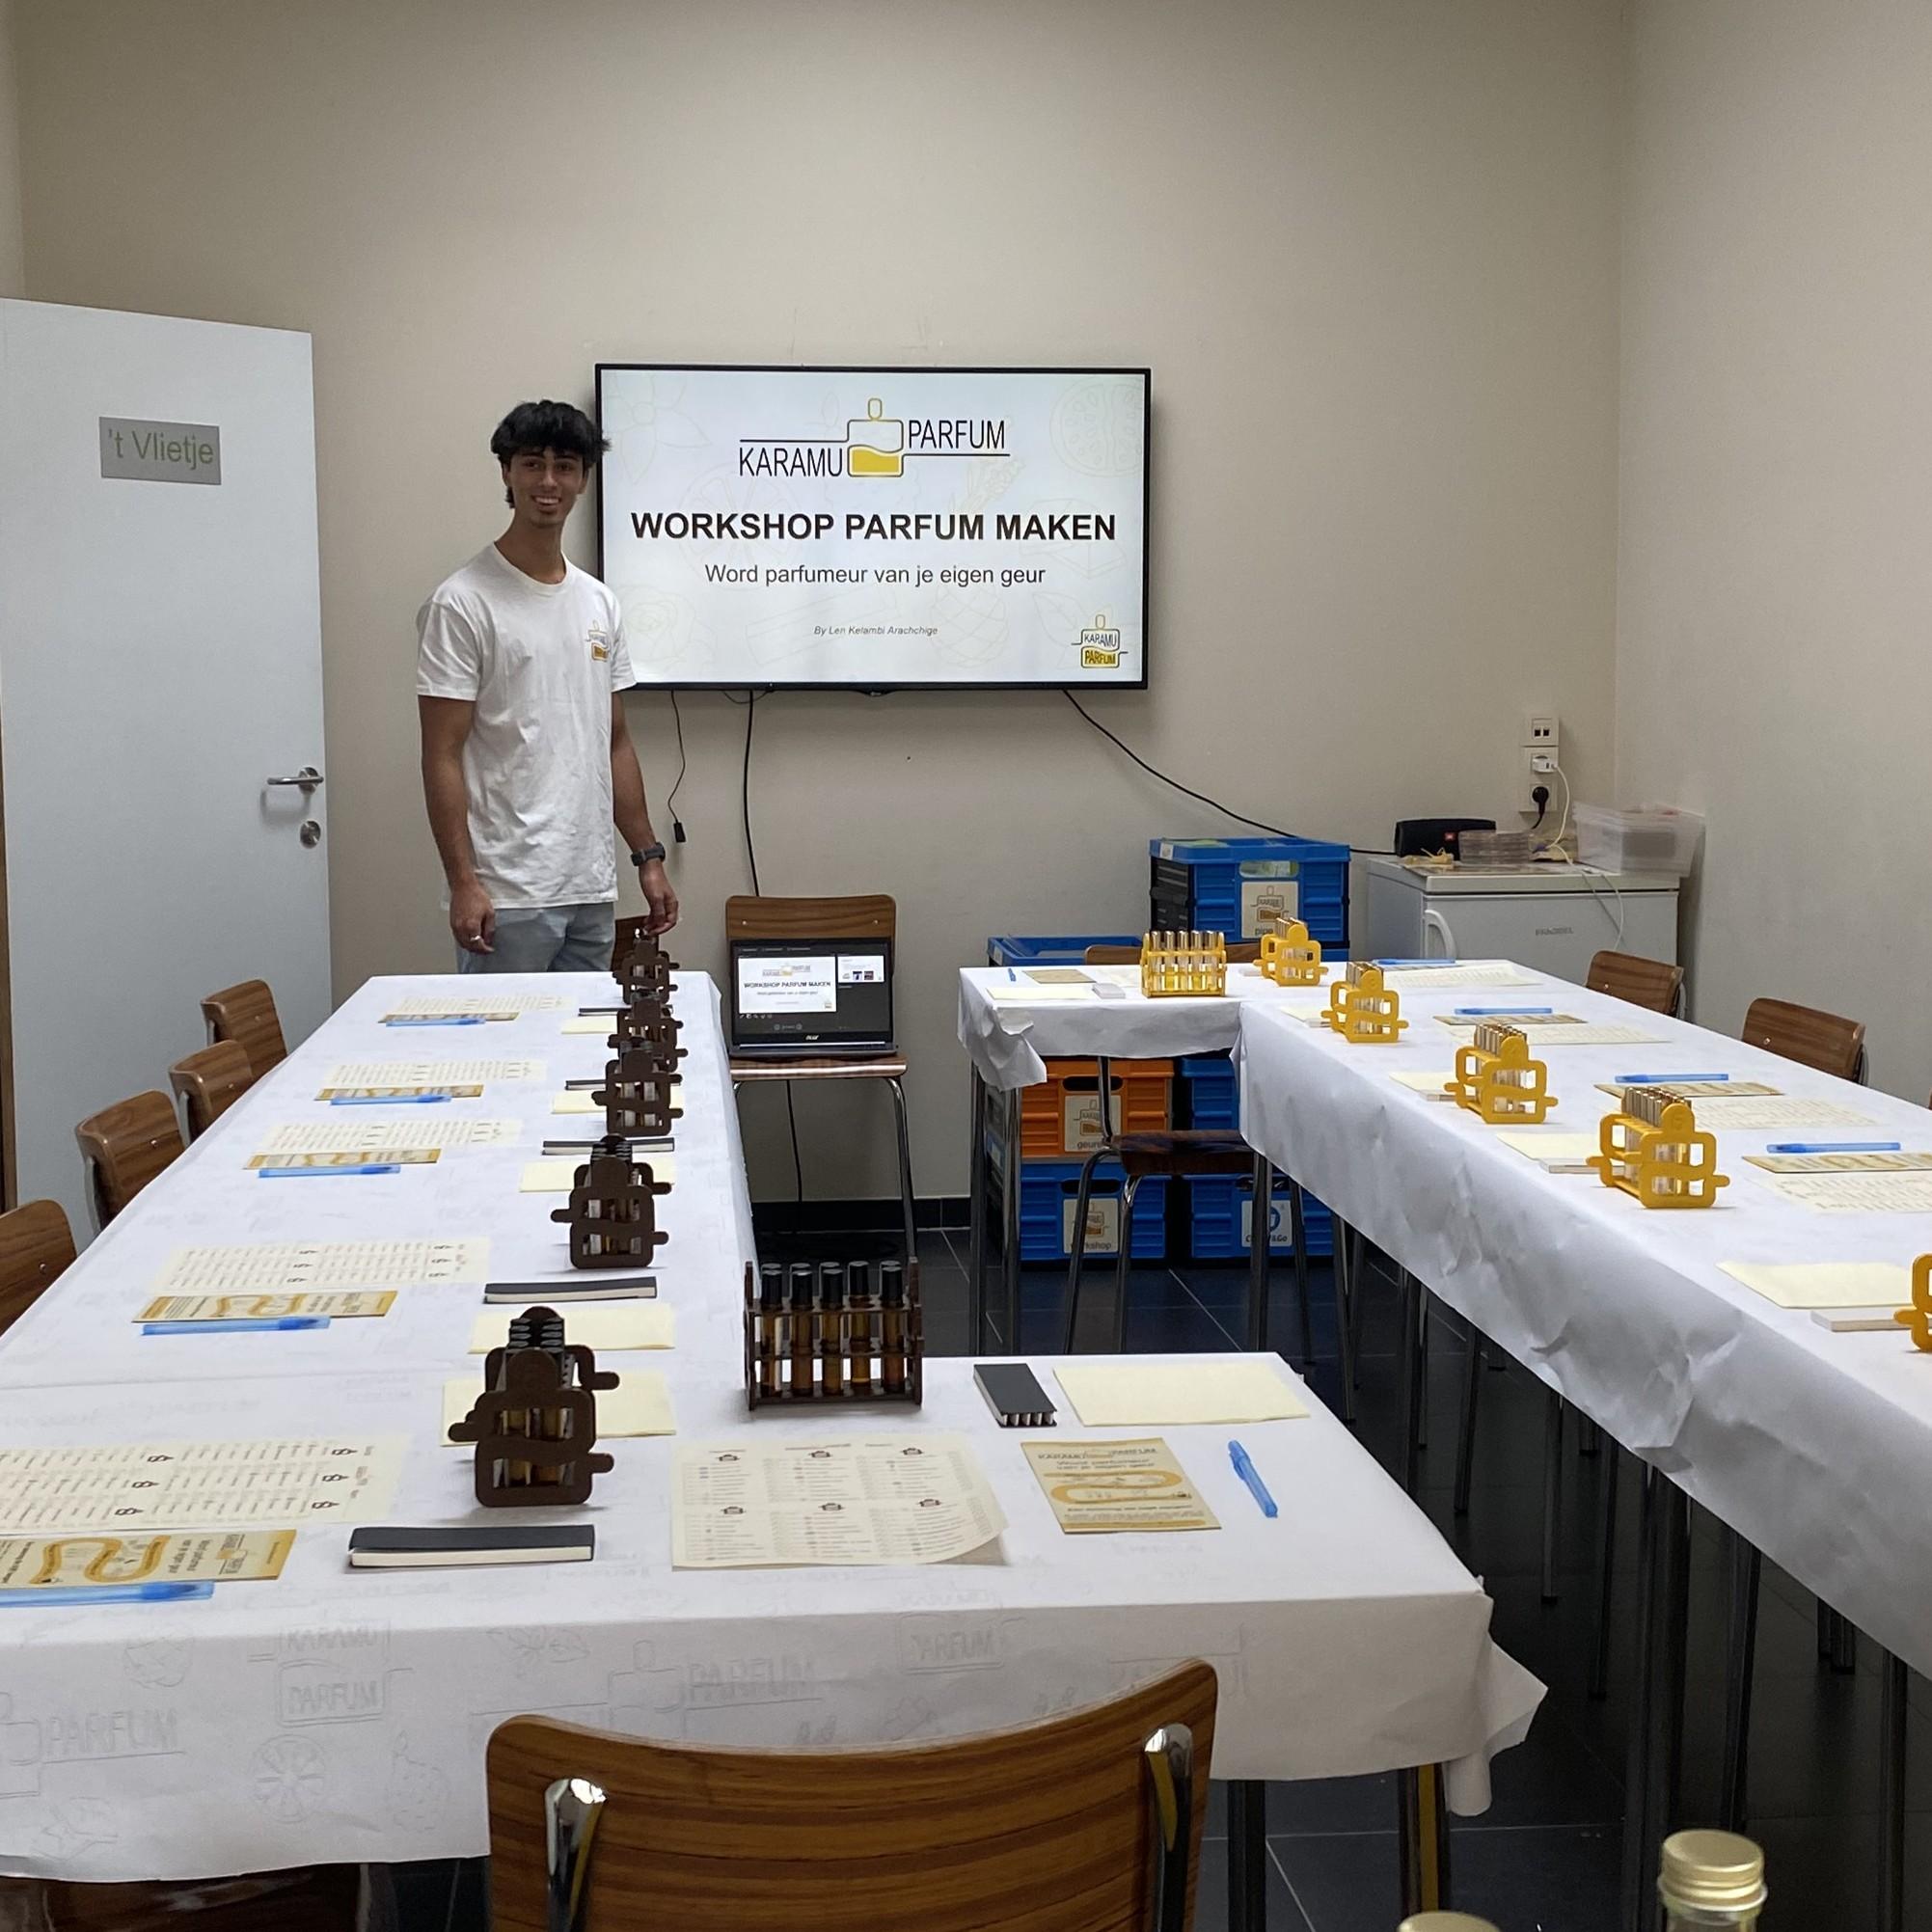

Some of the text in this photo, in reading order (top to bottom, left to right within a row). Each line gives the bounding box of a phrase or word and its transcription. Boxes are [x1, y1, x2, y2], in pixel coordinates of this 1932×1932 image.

[908, 419, 1005, 450] PARFUM
[108, 428, 213, 471] 't Vlietje
[739, 447, 843, 478] KARAMU
[630, 511, 1116, 541] WORKSHOP PARFUM MAKEN
[704, 563, 1047, 588] Word parfumeur van je eigen geur
[813, 625, 939, 638] By Len Kelambi Arachchige
[1083, 633, 1117, 647] KARAMU
[1084, 649, 1117, 665] PARFUM
